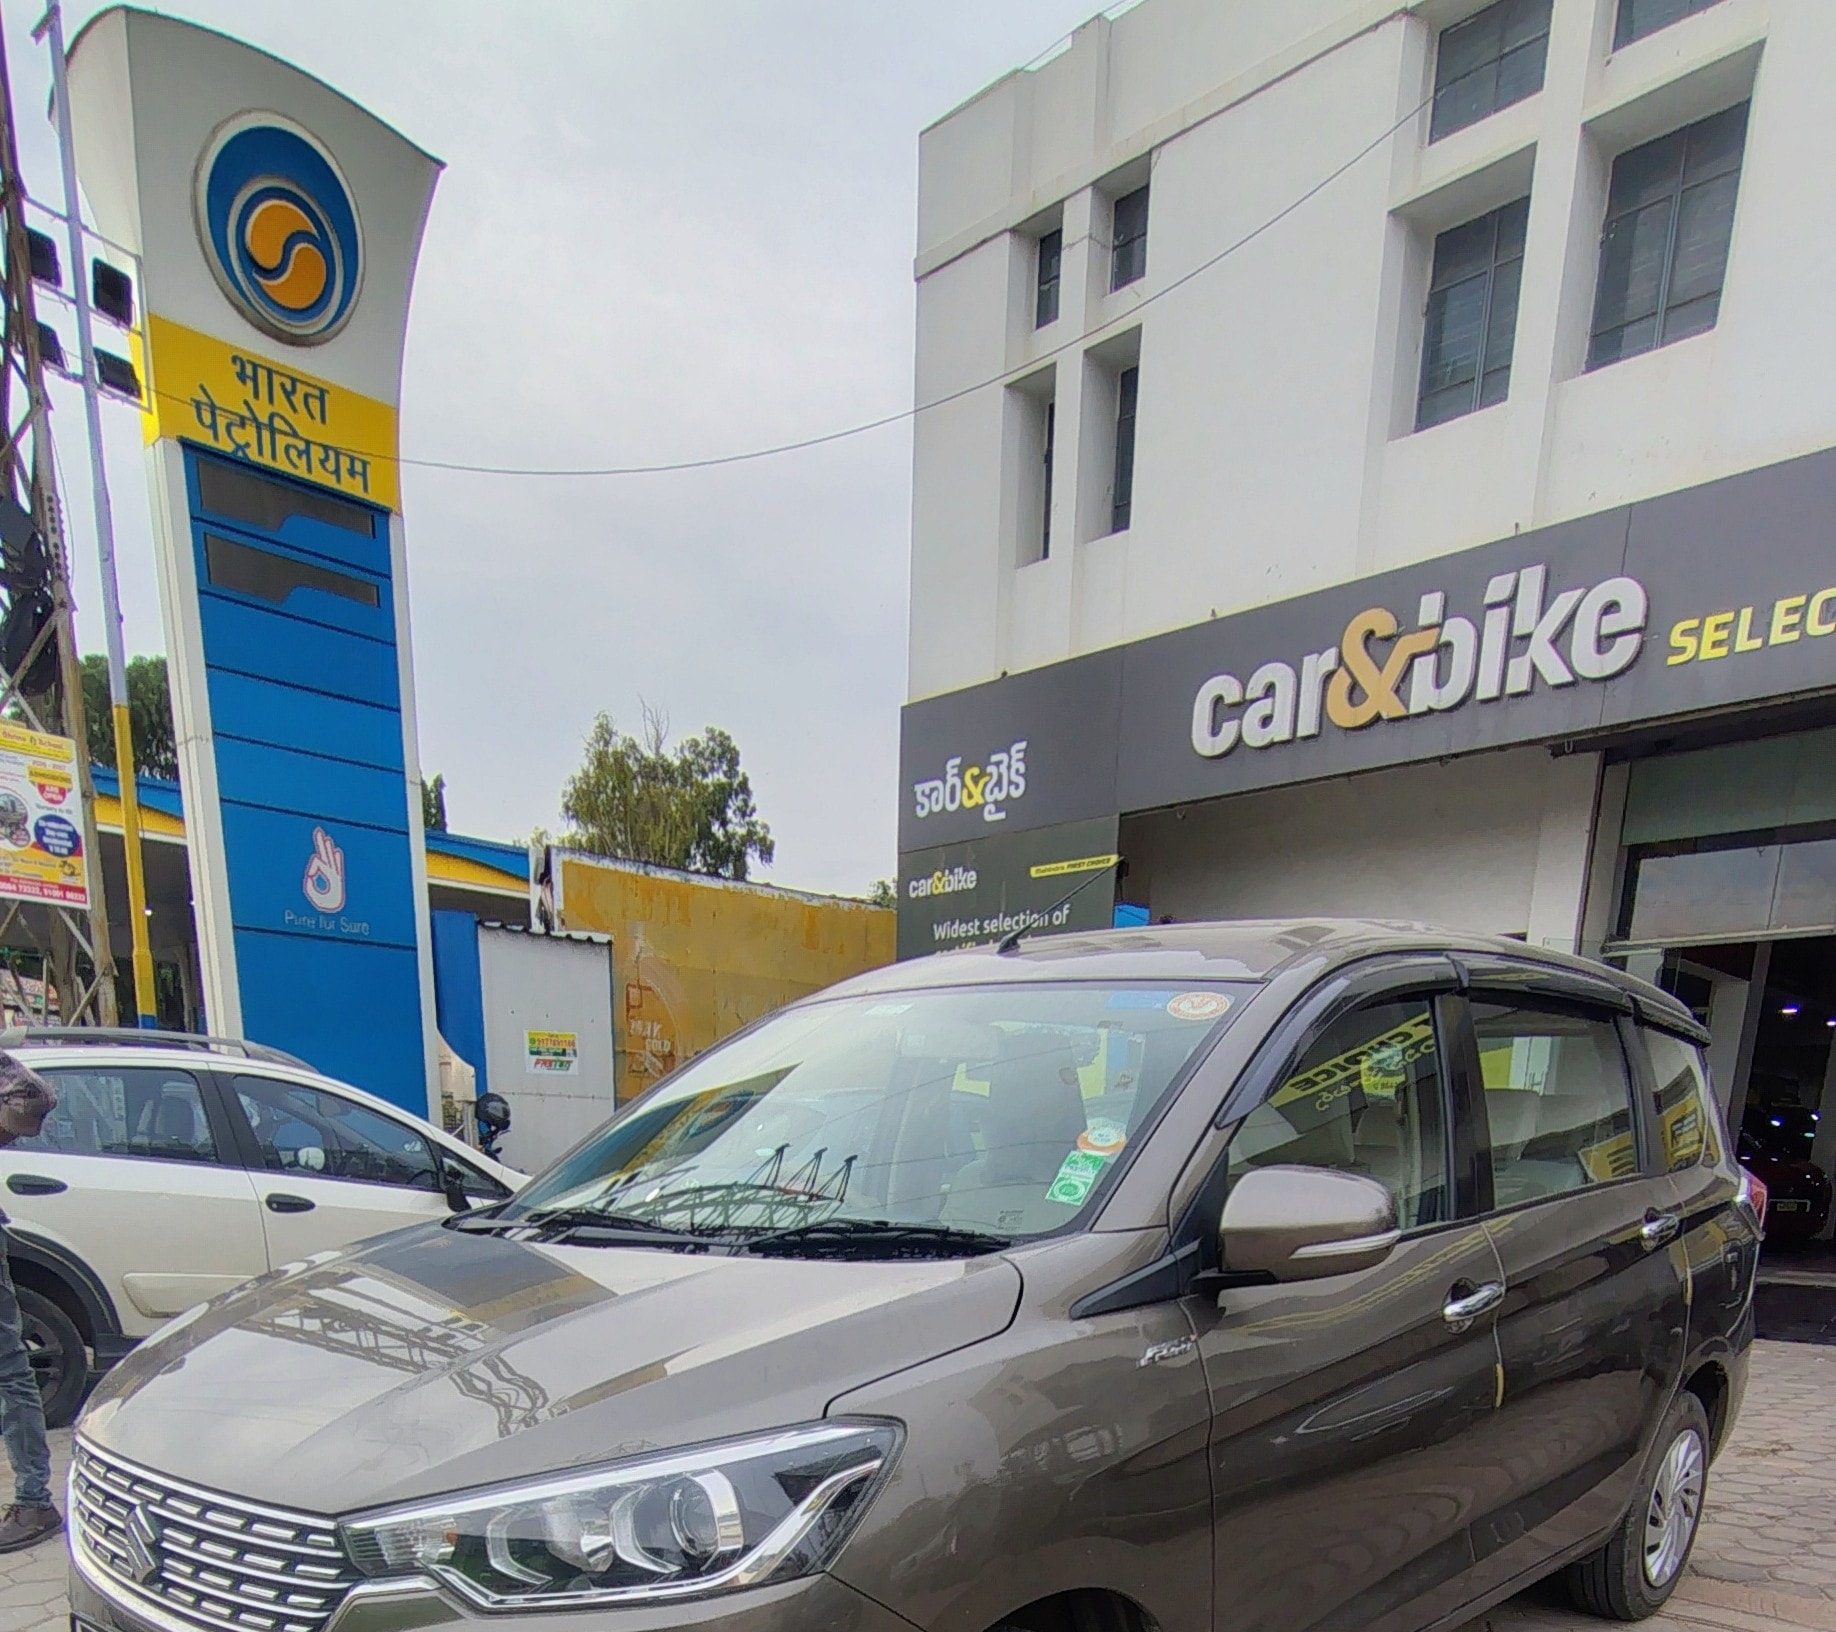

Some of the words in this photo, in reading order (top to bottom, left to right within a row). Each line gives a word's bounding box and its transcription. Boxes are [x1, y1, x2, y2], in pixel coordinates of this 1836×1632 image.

[231, 353, 329, 425] भारत
[191, 384, 371, 494] पेट्रोलियम
[1191, 563, 1649, 759] car&bike
[1666, 586, 1836, 666] SELEC
[914, 741, 1028, 822] కార్&బైక్
[909, 867, 978, 898] car&bike
[284, 910, 316, 930] Pure
[319, 915, 336, 930] for
[340, 917, 370, 935] Sure
[933, 918, 980, 941] Widest
[1052, 904, 1070, 925] of
